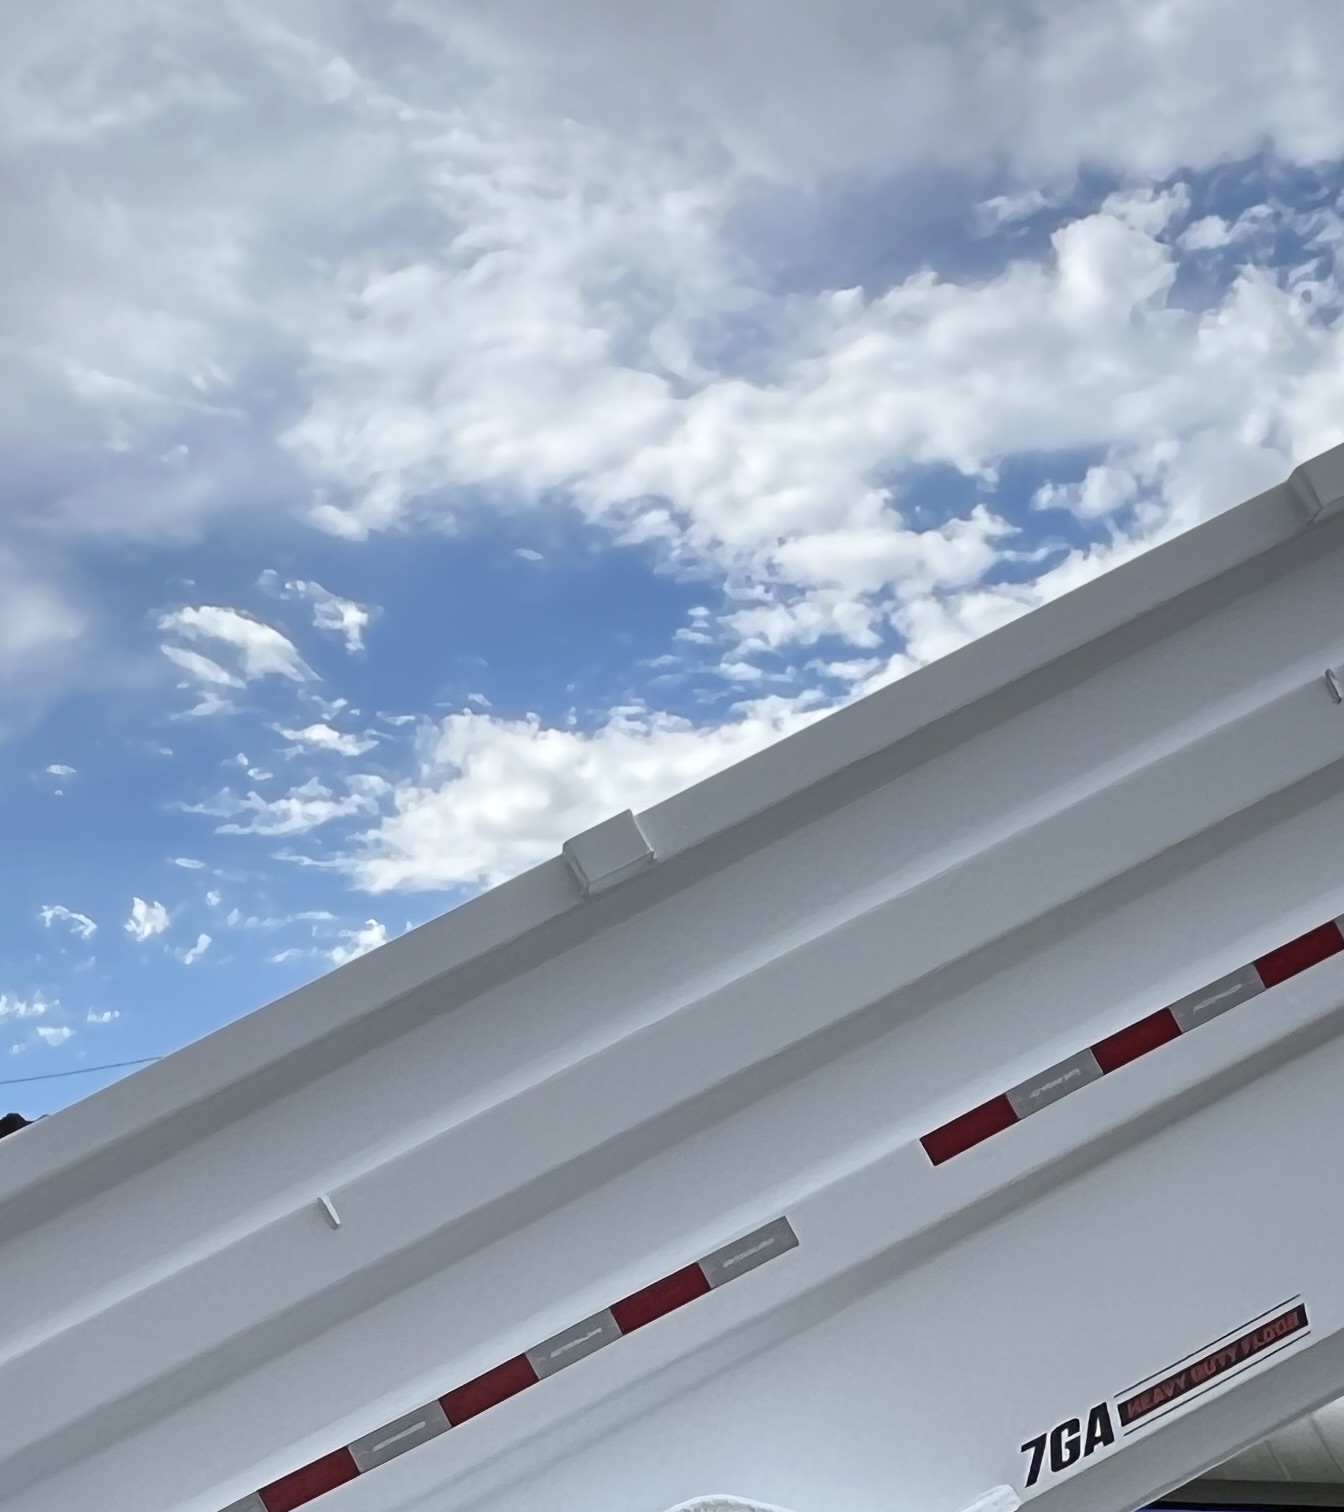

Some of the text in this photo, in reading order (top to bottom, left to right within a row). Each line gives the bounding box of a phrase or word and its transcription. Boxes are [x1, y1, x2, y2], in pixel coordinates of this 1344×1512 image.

[1127, 1373, 1187, 1418] HEAVY
[1190, 1345, 1237, 1382] DUTY
[1021, 1401, 1115, 1489] 7GA
